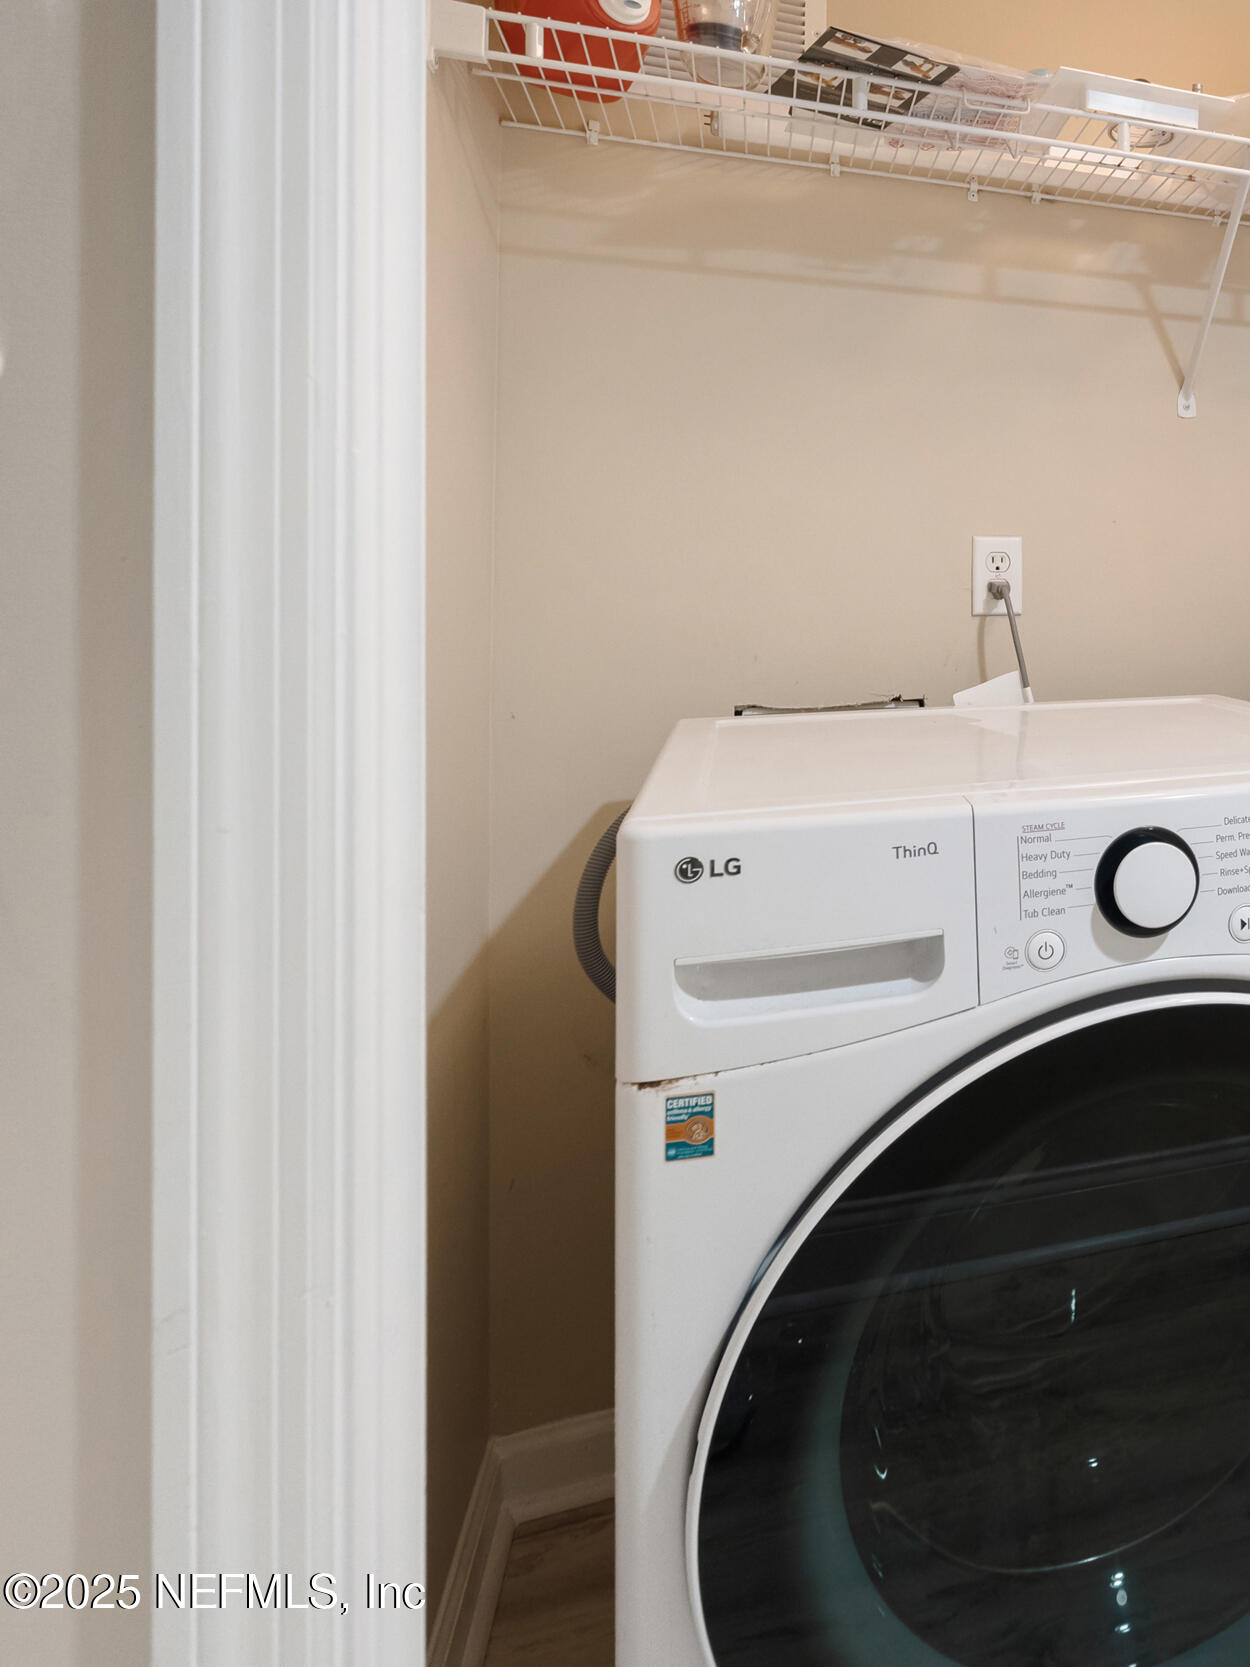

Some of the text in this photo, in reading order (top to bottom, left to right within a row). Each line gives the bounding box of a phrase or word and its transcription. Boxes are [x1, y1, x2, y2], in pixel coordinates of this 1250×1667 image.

[1022, 821, 1065, 833] STEAM CYCLE
[1020, 833, 1052, 845] Normal
[1215, 833, 1236, 843] Perm.
[892, 841, 939, 860] ThinQ
[1021, 850, 1071, 863] Heavy Duty
[1215, 849, 1238, 861] Speed
[709, 857, 742, 878] LG
[1022, 868, 1057, 880] Bedding
[1024, 906, 1066, 919] Tub Clean
[667, 1095, 713, 1109] CERTIFIED
